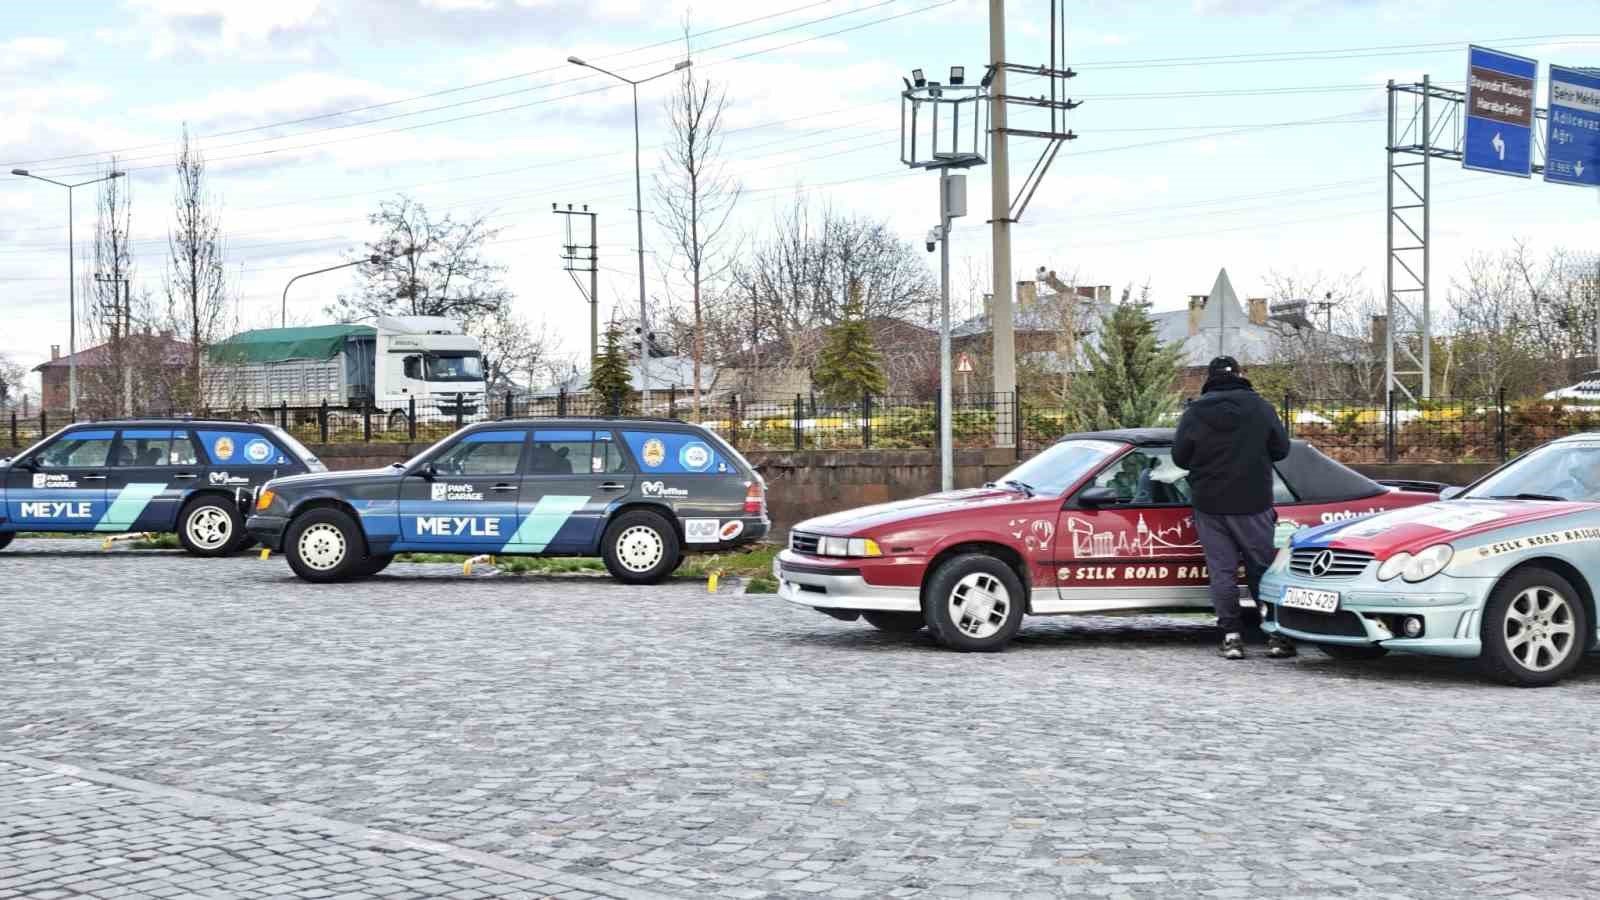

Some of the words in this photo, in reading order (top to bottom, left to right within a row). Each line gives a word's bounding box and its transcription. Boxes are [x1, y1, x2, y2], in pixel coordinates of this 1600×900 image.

[447, 493, 484, 501] GARAGE
[21, 502, 93, 518] MEYLE
[416, 517, 501, 536] MEYLE
[1493, 541, 1523, 555] SILK
[1527, 534, 1560, 548] ROAD
[1076, 566, 1116, 580] SILK
[1124, 566, 1169, 580] ROAD
